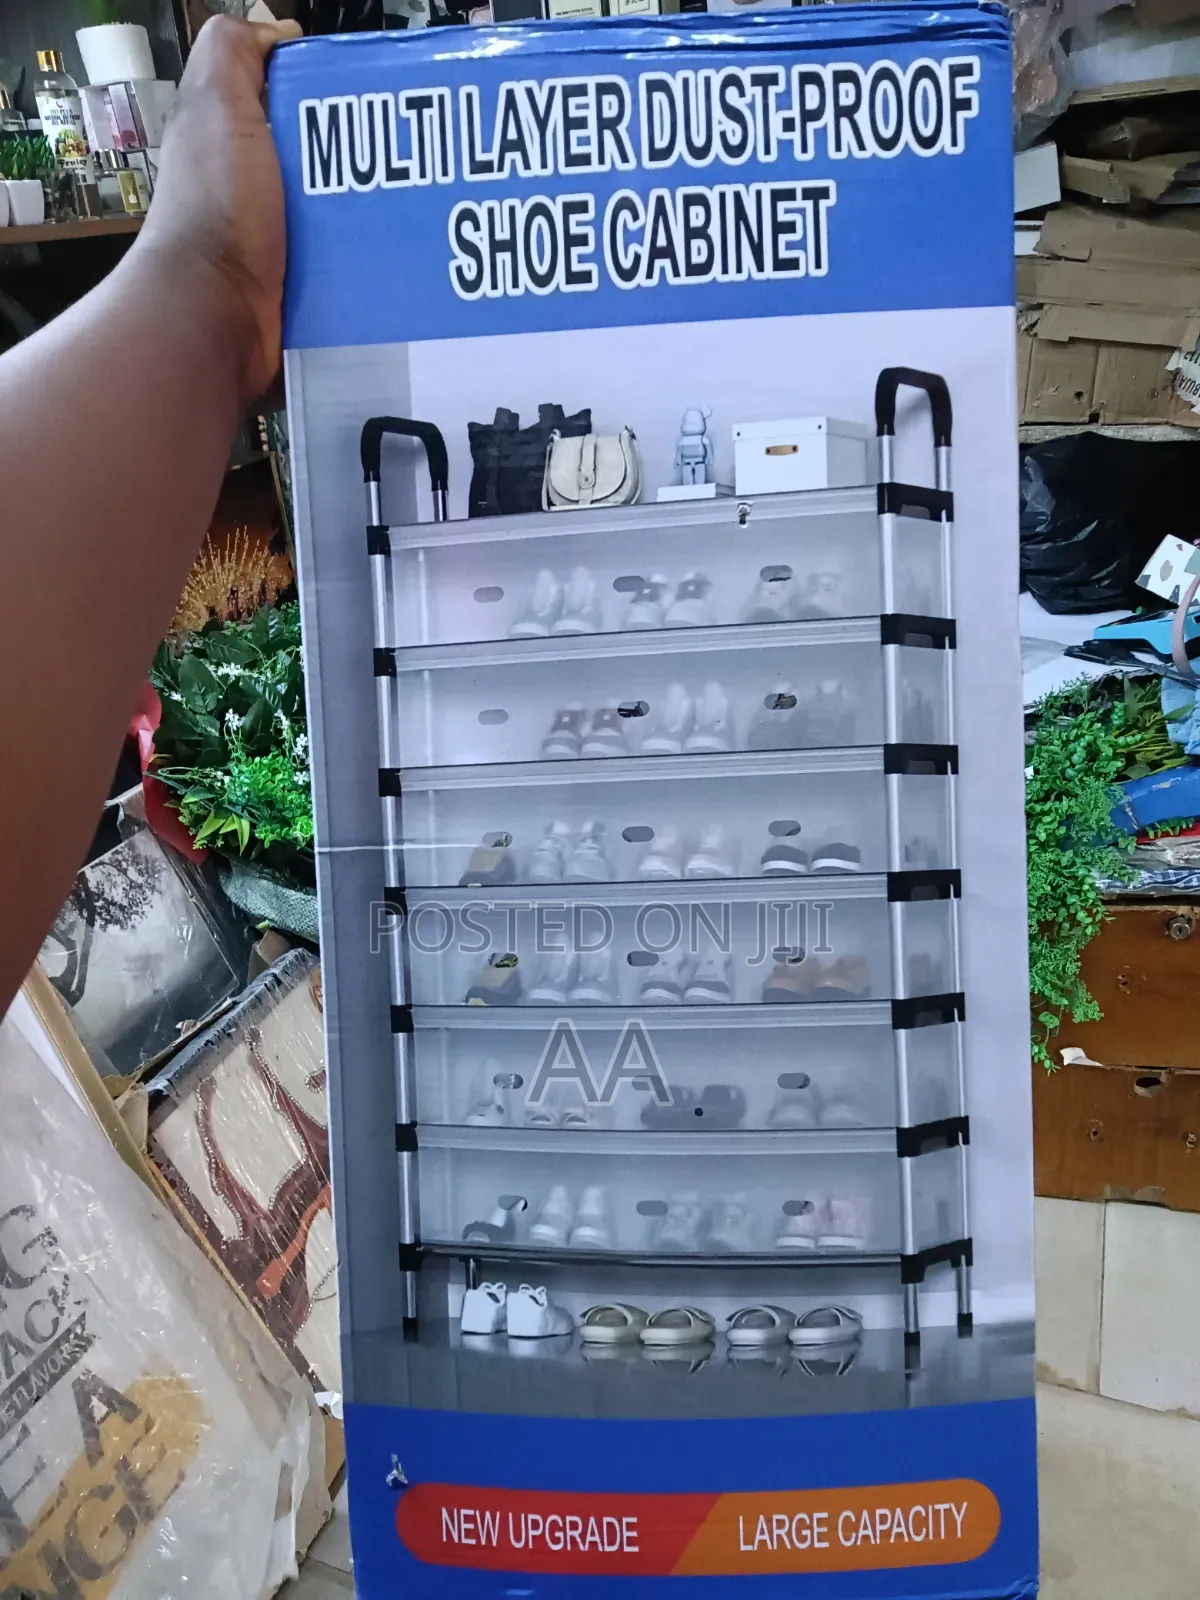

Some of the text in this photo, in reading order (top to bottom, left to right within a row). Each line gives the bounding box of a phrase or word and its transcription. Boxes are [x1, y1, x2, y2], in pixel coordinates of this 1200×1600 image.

[299, 55, 981, 196] MULTI LAYER DUST-PROOF
[449, 179, 837, 301] SHOE CABINET
[1179, 375, 1200, 398] BUJA
[441, 1501, 968, 1553] NEW UPGRADE LARGE CAPACITY
